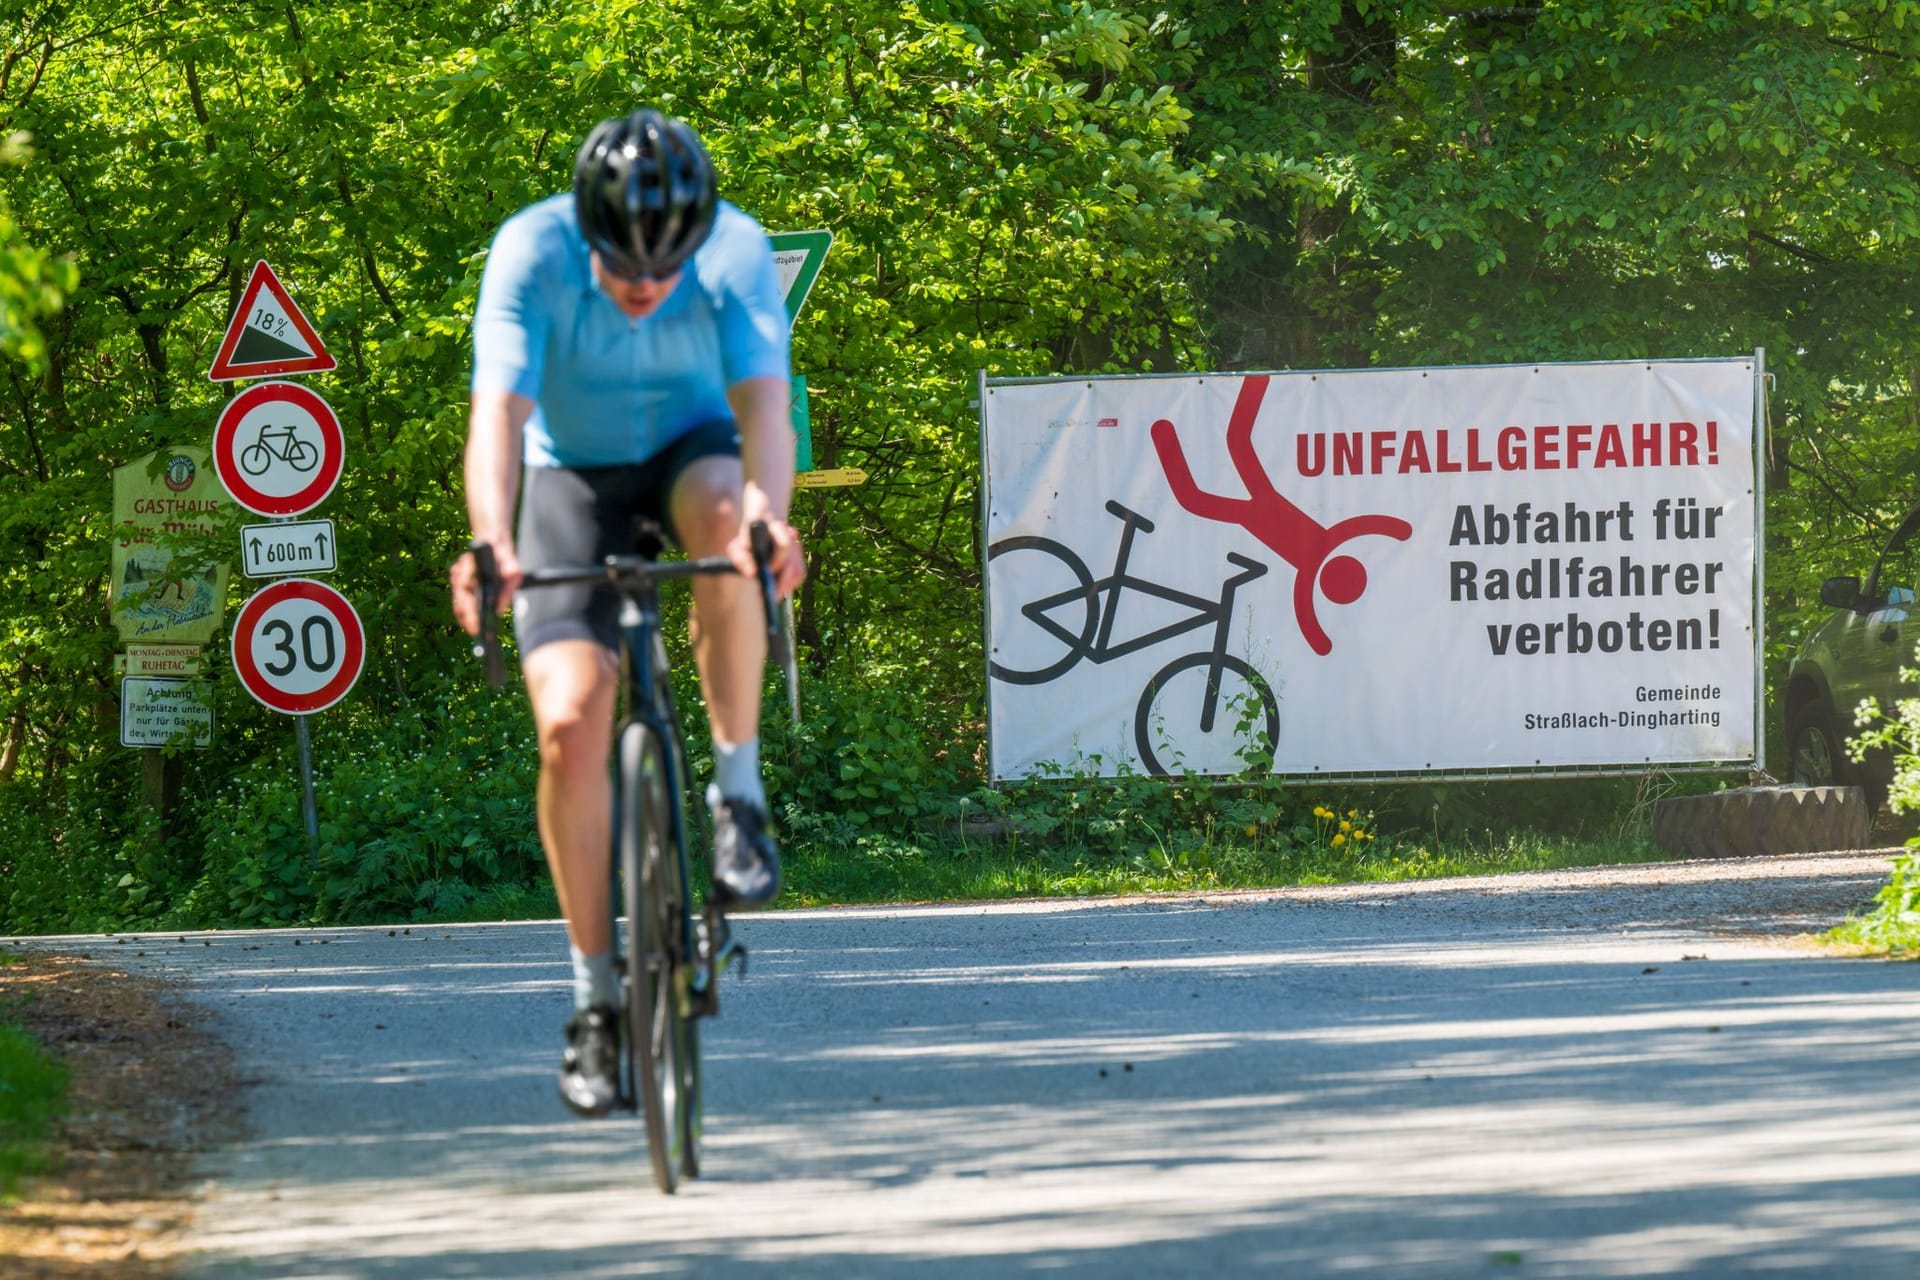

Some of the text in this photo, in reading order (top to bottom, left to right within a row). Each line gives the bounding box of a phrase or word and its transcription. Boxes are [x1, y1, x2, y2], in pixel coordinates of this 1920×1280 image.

[254, 309, 288, 337] 18%
[1297, 421, 1719, 477] UNFALLGEFAHR!
[134, 498, 218, 514] GASTHAUS
[1449, 497, 1723, 546] Abfahrt für
[1450, 556, 1723, 602] Radlfahrer
[1487, 608, 1720, 655] verboten!
[129, 649, 161, 657] MONTAG
[165, 649, 198, 658] DIENSTAG
[262, 615, 336, 677] 30
[141, 660, 185, 671] RUHETAG
[1636, 684, 1721, 702] Gemeinde
[129, 702, 208, 714] Parkplätze unten
[136, 717, 152, 726] nur
[156, 716, 169, 726] für
[1525, 709, 1720, 730] Straßlach-Dingharting
[129, 728, 146, 738] des
